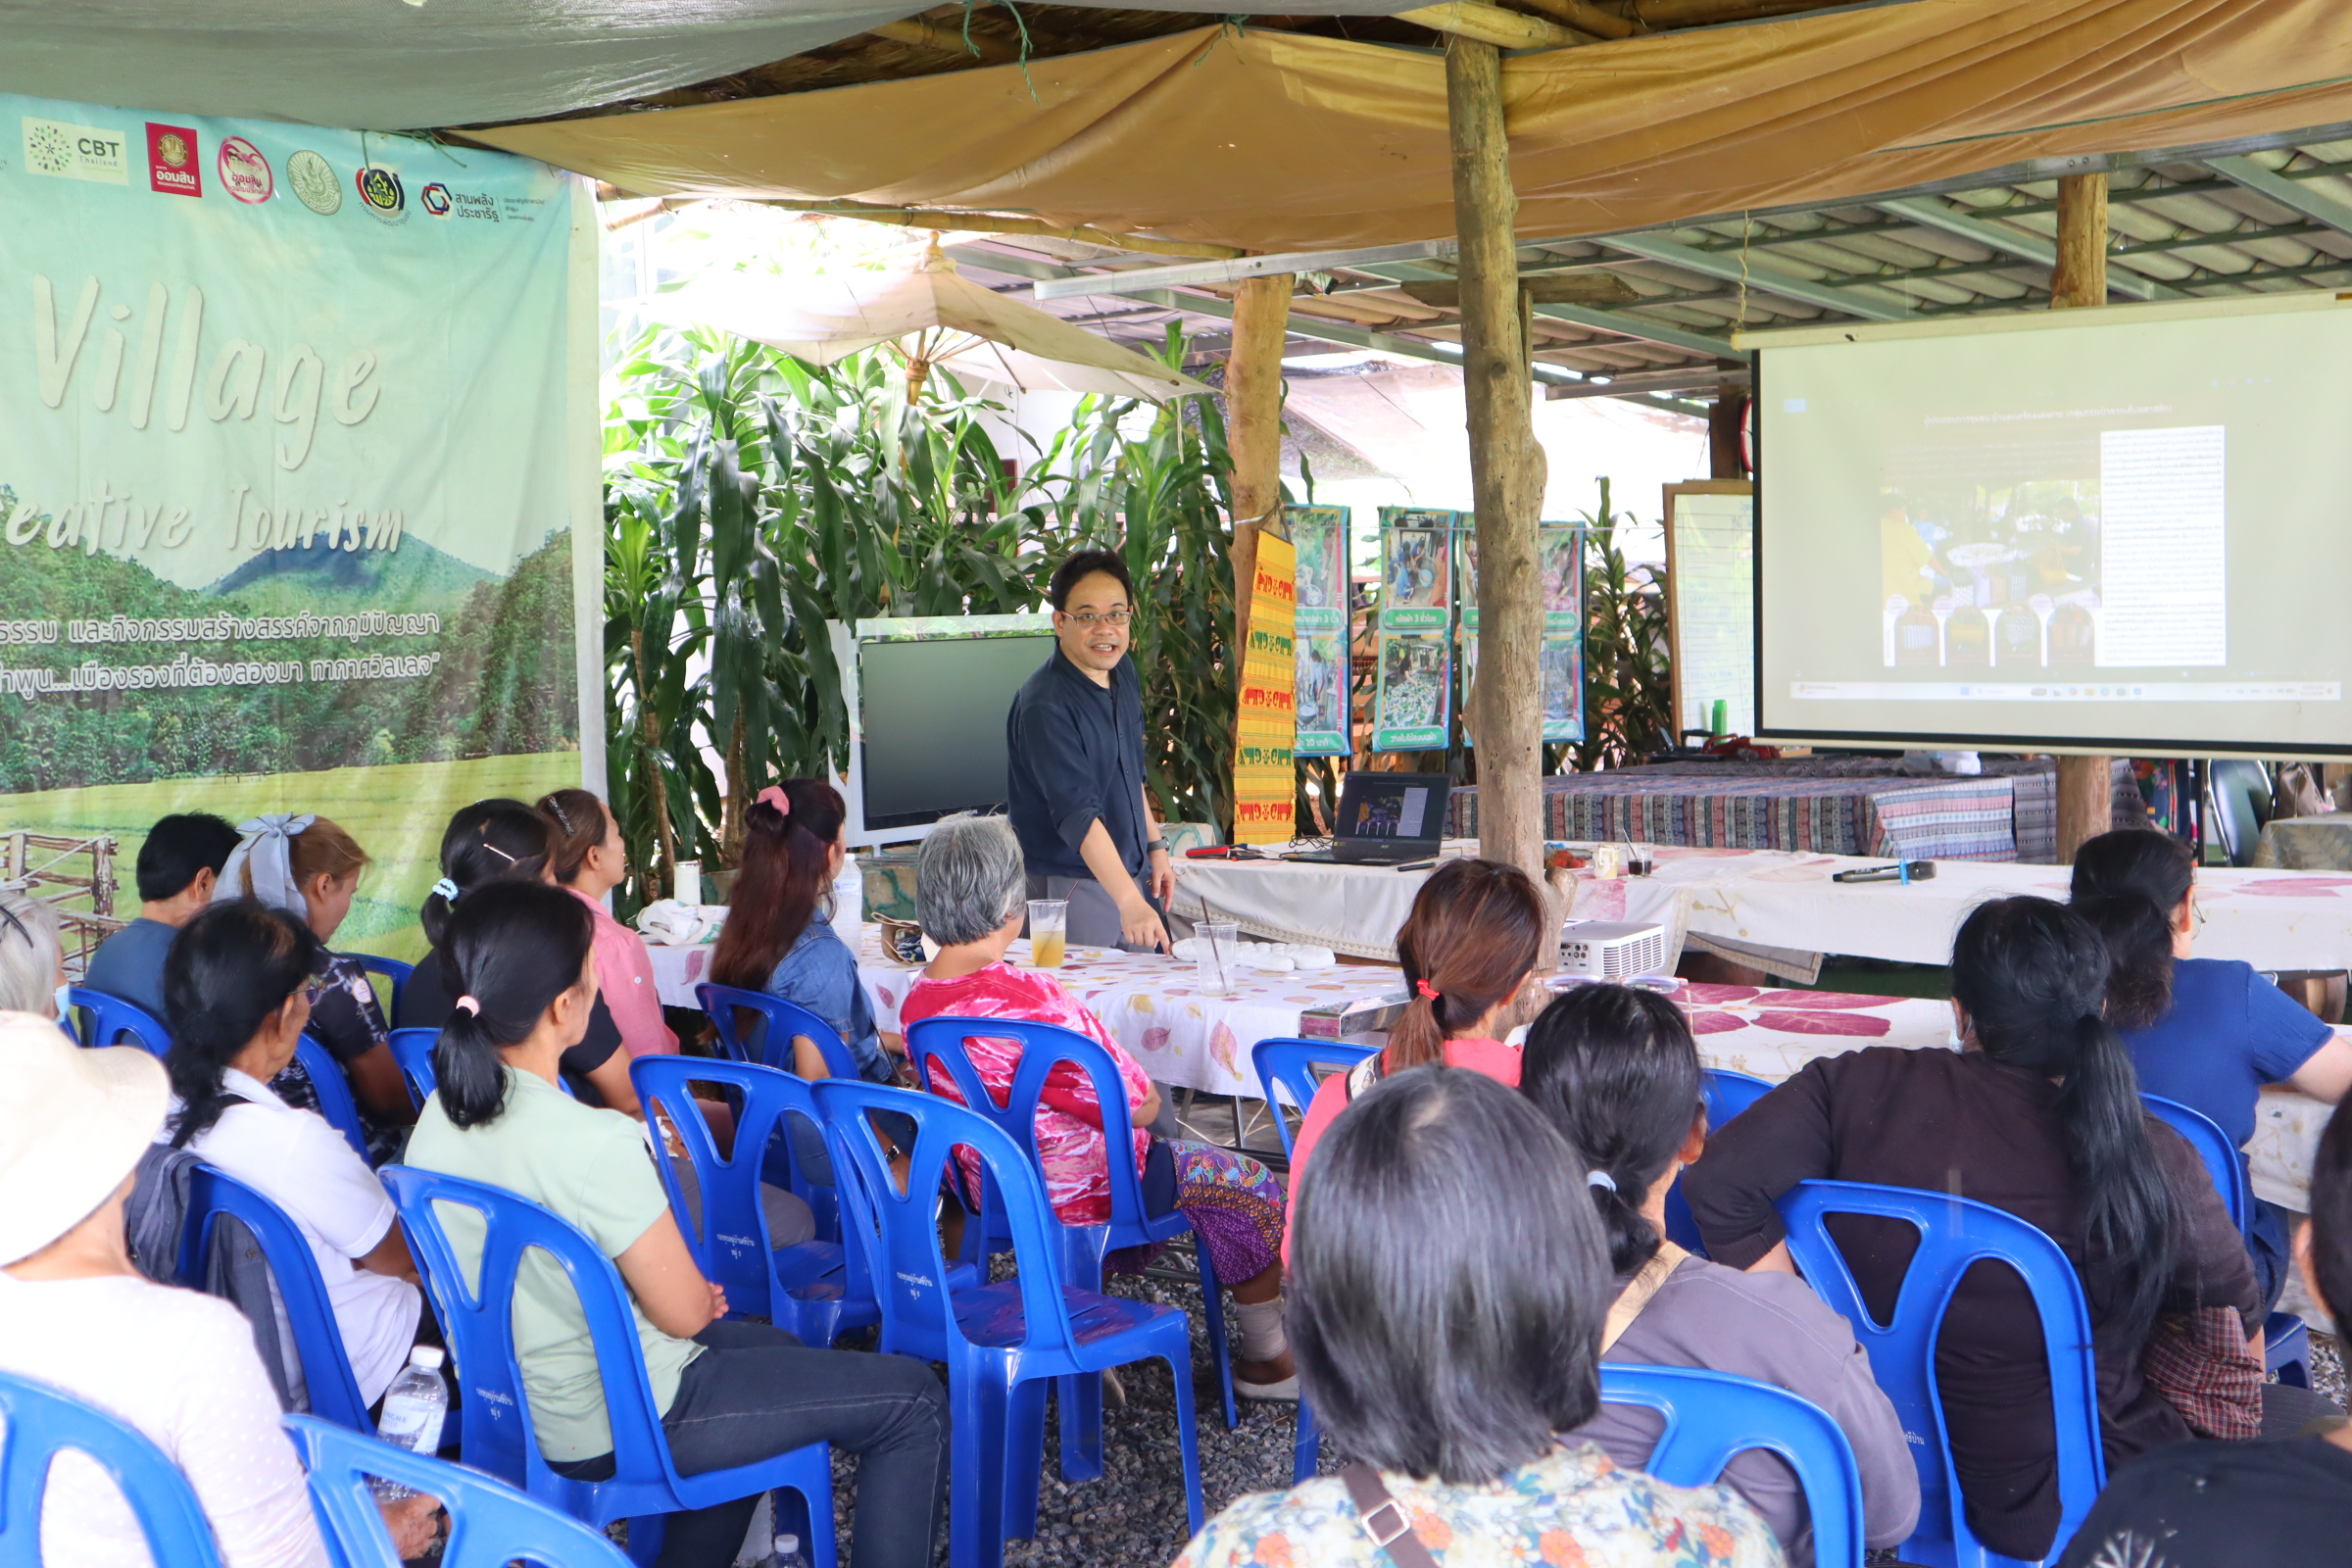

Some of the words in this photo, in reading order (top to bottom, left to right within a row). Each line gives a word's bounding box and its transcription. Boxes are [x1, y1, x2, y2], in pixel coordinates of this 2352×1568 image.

[77, 138, 120, 158] CBT
[78, 155, 118, 167] Thailand
[156, 171, 196, 185] ออมสิน
[455, 192, 494, 206] สานพลัง
[457, 205, 501, 223] ประชารัฐ
[32, 272, 381, 470] Village
[226, 482, 403, 553] Tourism
[69, 609, 440, 644] และกิจกรรมสร้างสรรค์จากภูมิปัญญา
[1305, 737, 1315, 747] 20
